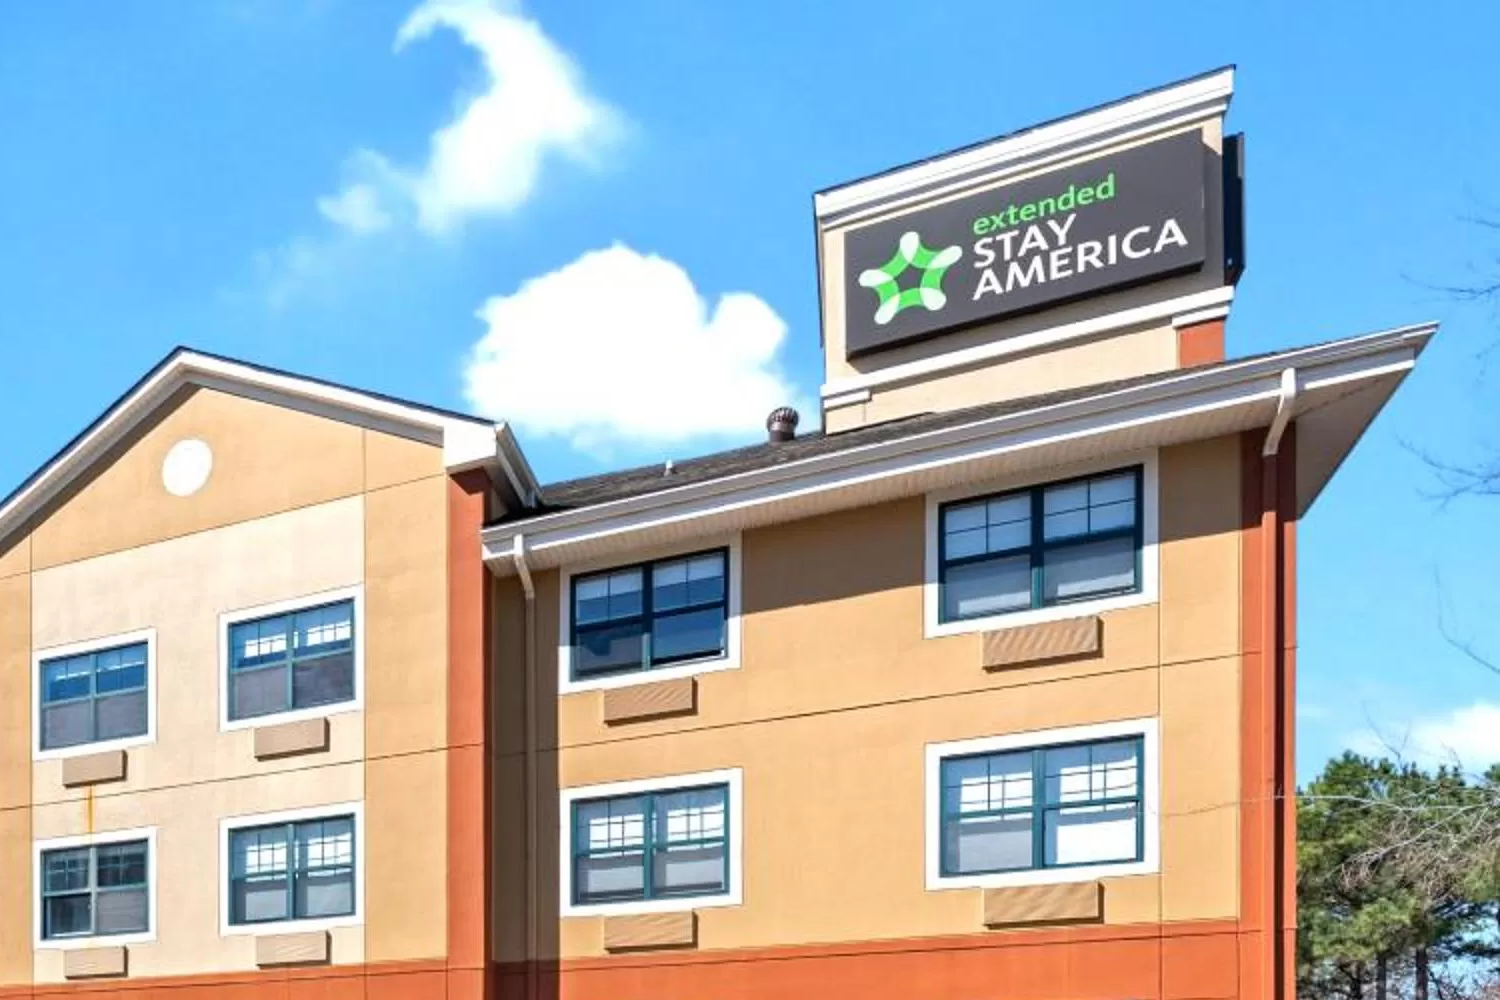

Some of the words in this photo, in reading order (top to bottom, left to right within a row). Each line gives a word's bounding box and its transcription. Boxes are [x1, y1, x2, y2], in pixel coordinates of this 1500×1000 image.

[973, 172, 1116, 235] extended
[972, 218, 1189, 301] AMERICA
[973, 213, 1077, 268] STAY
